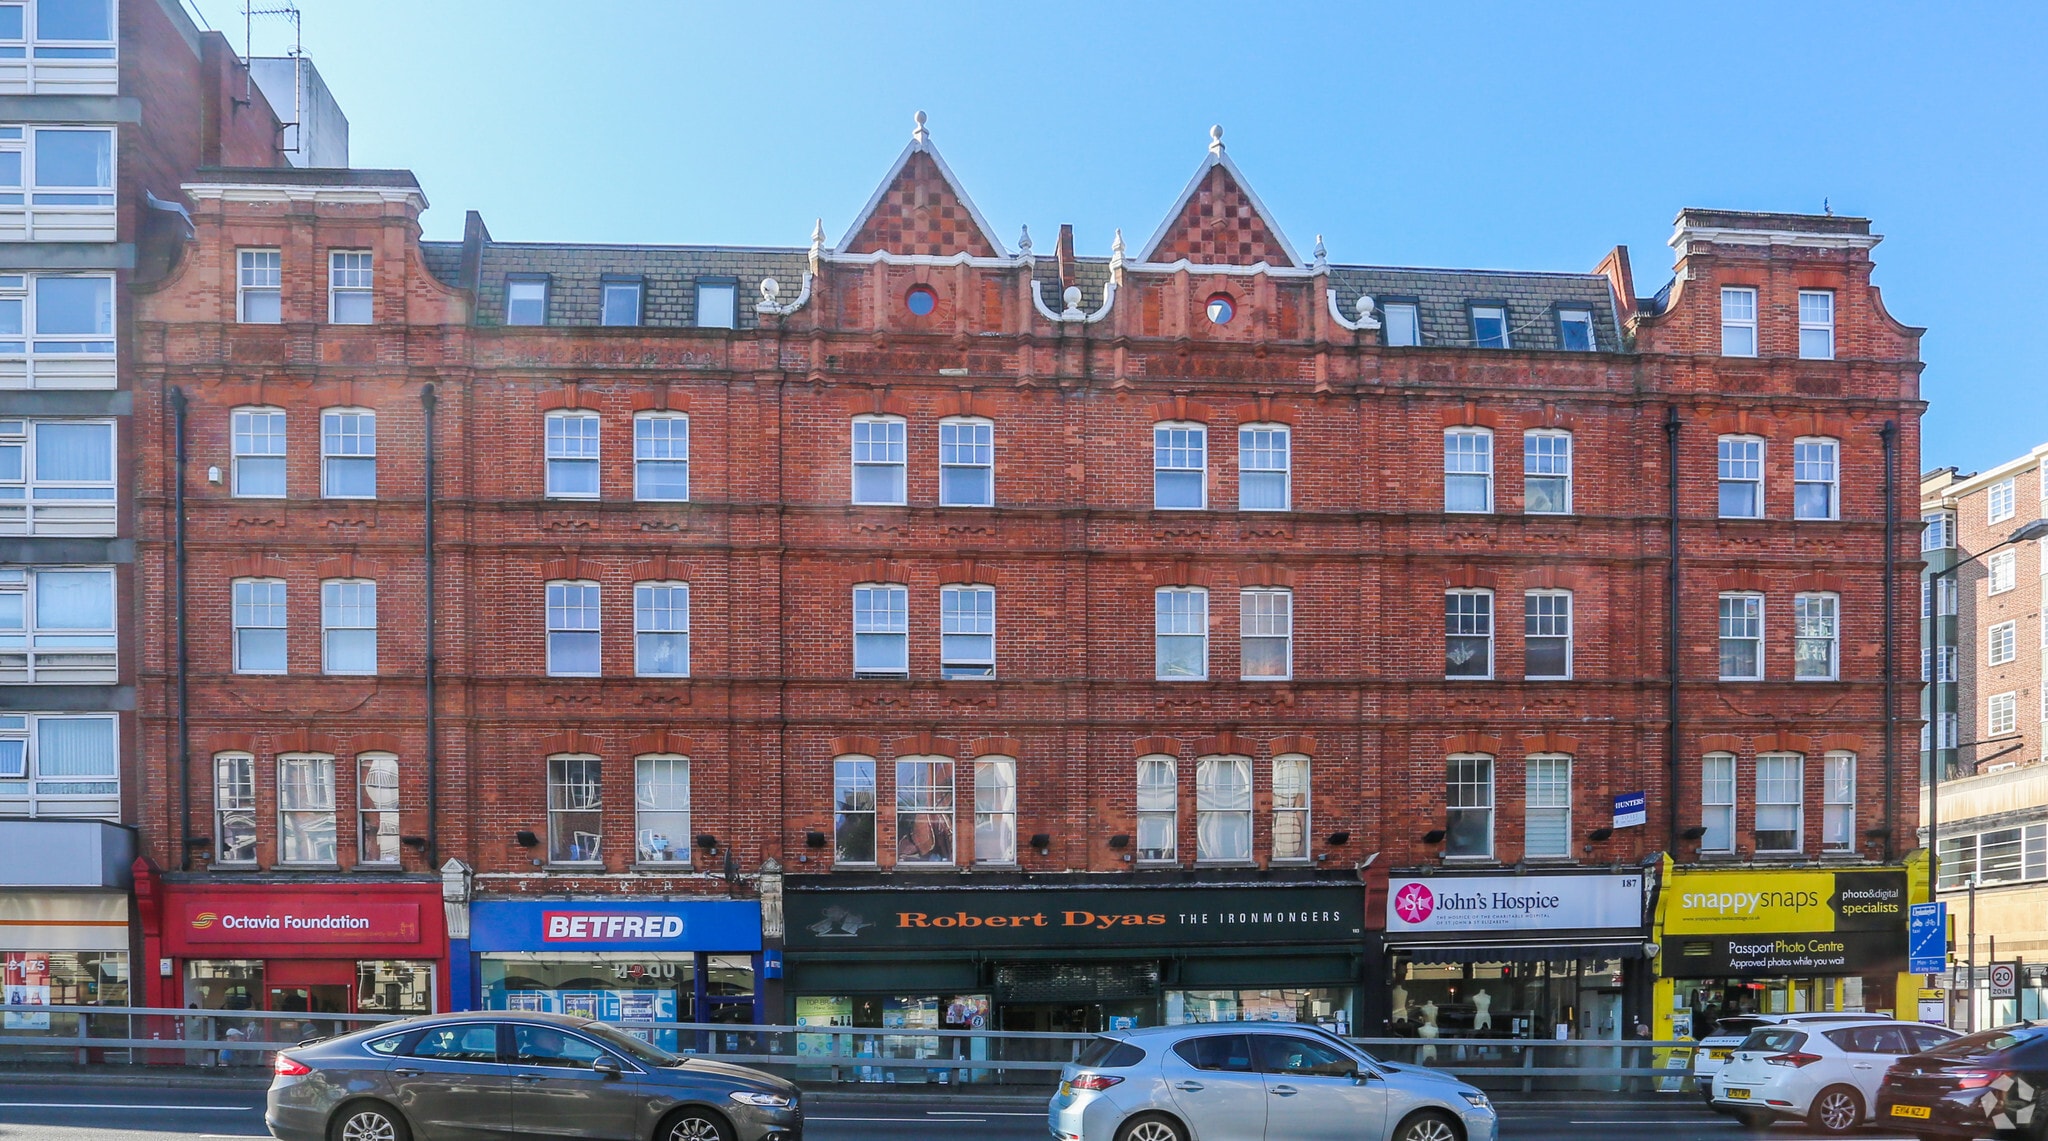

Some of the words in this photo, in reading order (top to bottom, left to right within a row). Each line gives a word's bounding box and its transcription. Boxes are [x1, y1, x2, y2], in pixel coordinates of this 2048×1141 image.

[1615, 797, 1644, 809] HUNTERS
[1621, 878, 1637, 888] 187
[1842, 888, 1898, 901] photo&digital
[1403, 893, 1424, 911] St
[1436, 891, 1487, 911] John's
[1492, 891, 1560, 914] Hospice
[1842, 902, 1898, 917] specialists
[222, 914, 279, 929] Octavia
[284, 914, 369, 929] Foundation
[548, 916, 684, 938] BETFRED
[895, 911, 1048, 928] Robert
[1061, 910, 1167, 931] Dyas
[1179, 913, 1209, 924] THE
[1219, 911, 1341, 924] IRONMONGERS
[1728, 941, 1774, 956] Passport
[1775, 940, 1806, 953] Photo
[1808, 939, 1844, 952] Centre
[1729, 957, 1766, 968] Approved
[1767, 957, 1792, 968] photos
[1792, 956, 1812, 966] while
[1813, 958, 1828, 968] you
[1828, 956, 1845, 966] wait
[1995, 972, 2010, 981] 20
